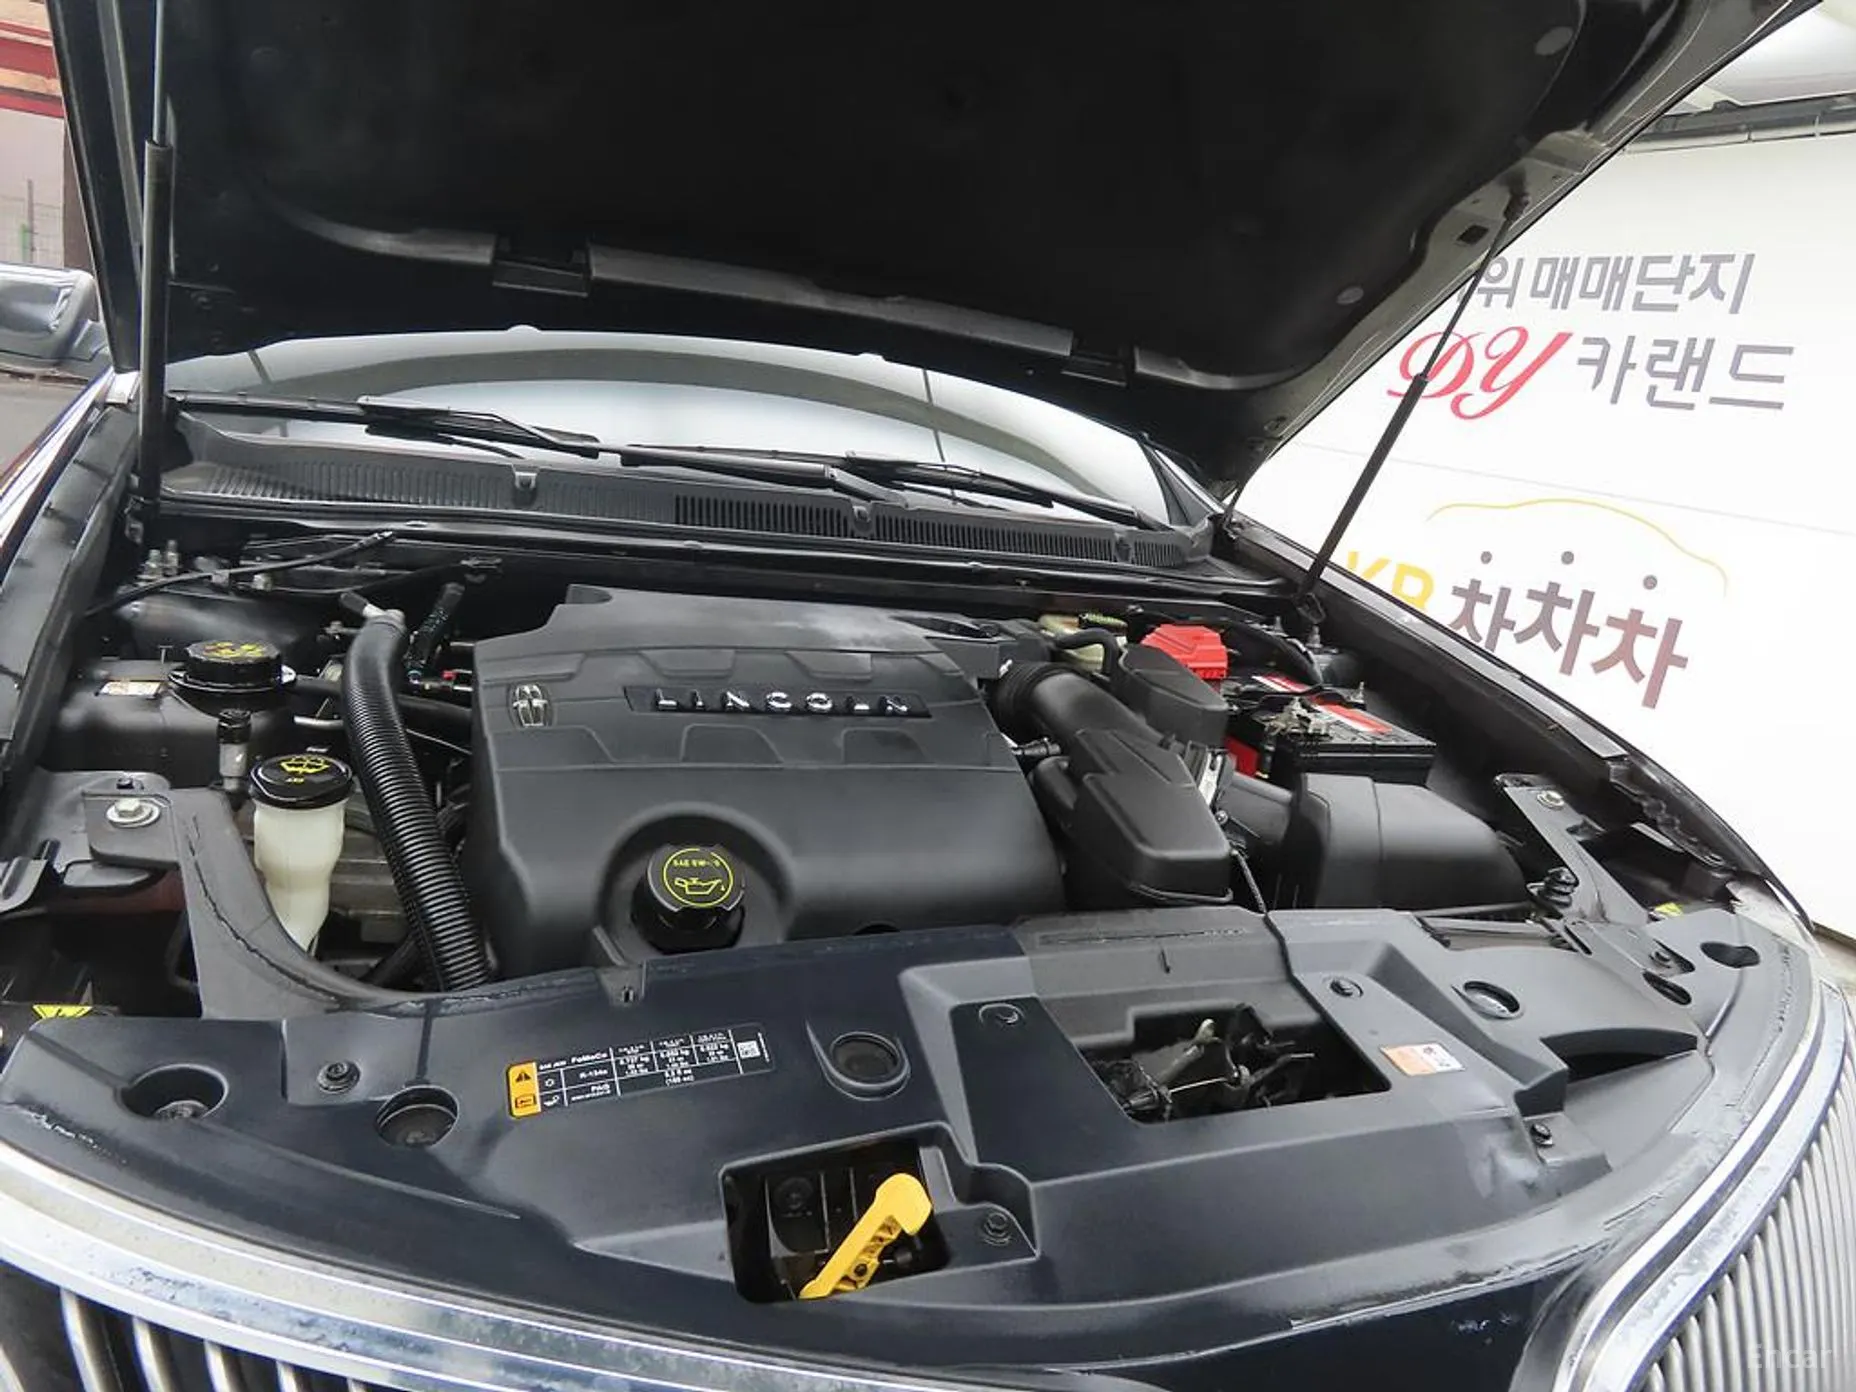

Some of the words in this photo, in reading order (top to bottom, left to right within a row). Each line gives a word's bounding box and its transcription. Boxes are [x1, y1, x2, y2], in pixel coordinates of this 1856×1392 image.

[1577, 334, 1795, 411] 카랜드
[1447, 550, 1690, 710] 차차차
[655, 687, 912, 714] LINCOLN
